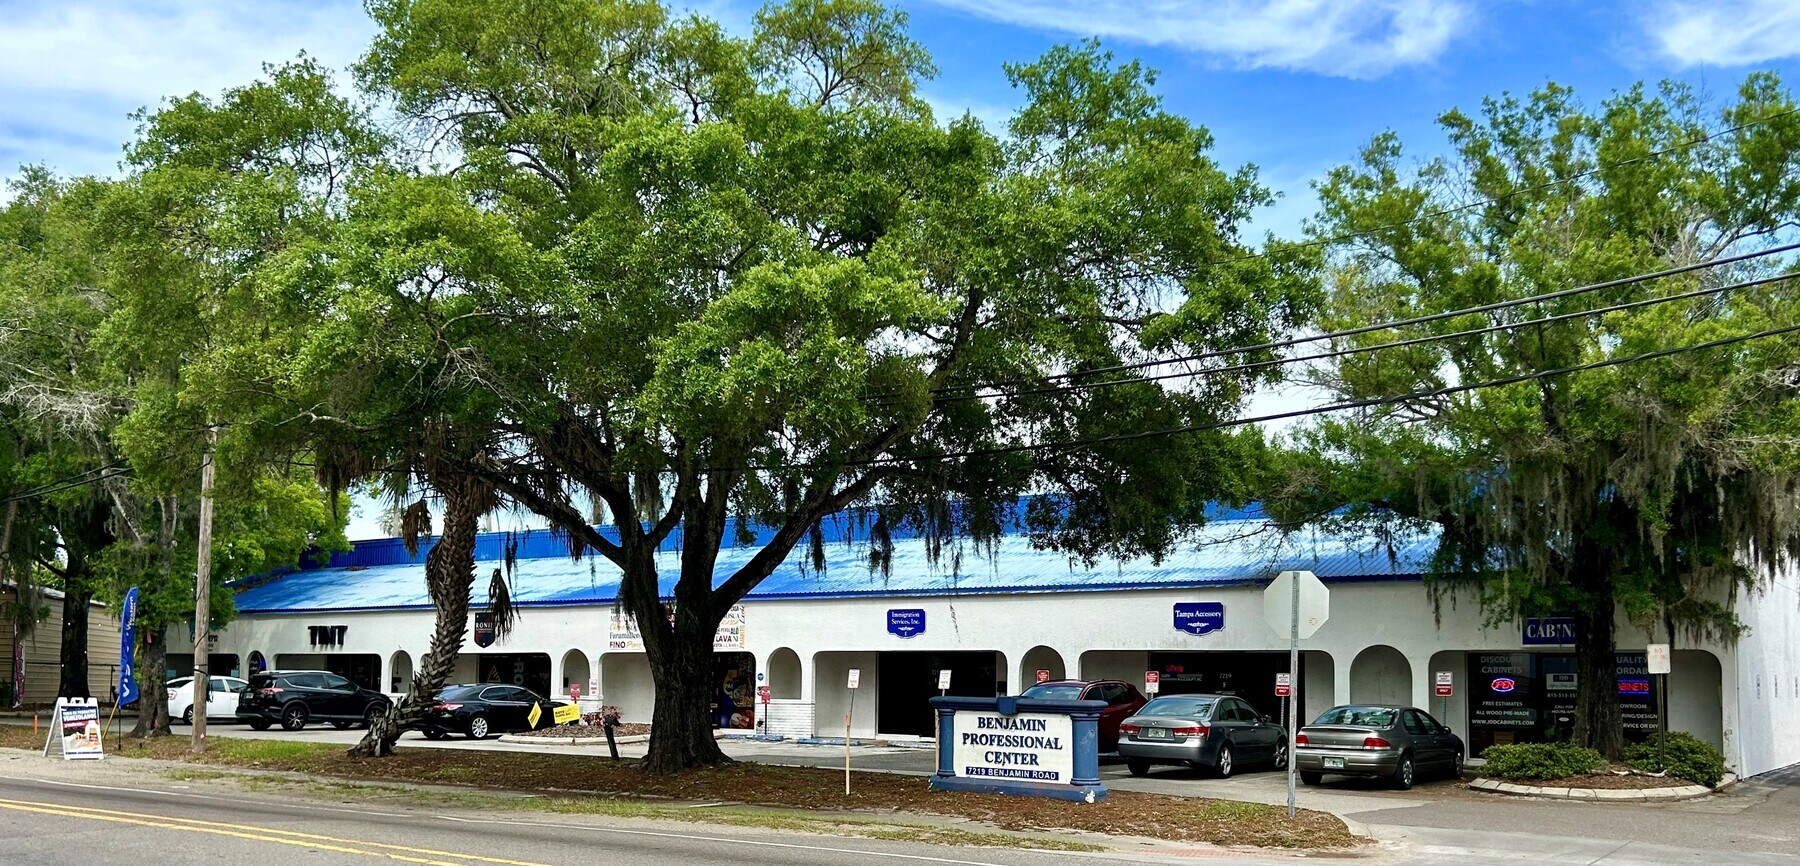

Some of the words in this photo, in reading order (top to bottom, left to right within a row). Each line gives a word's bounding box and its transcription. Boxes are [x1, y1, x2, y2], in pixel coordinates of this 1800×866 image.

[1175, 610, 1194, 618] Tampa
[1195, 610, 1222, 618] Accessory
[1481, 666, 1522, 674] CABINETS
[1495, 680, 1514, 690] OPEN
[977, 716, 1047, 732] BENJAMIN
[962, 732, 1063, 750] PROFESSIONAL
[984, 751, 1040, 767] CENTER
[967, 767, 986, 776] 7219
[987, 768, 1031, 778] BENJAMIN
[1032, 771, 1057, 780] ROAD
